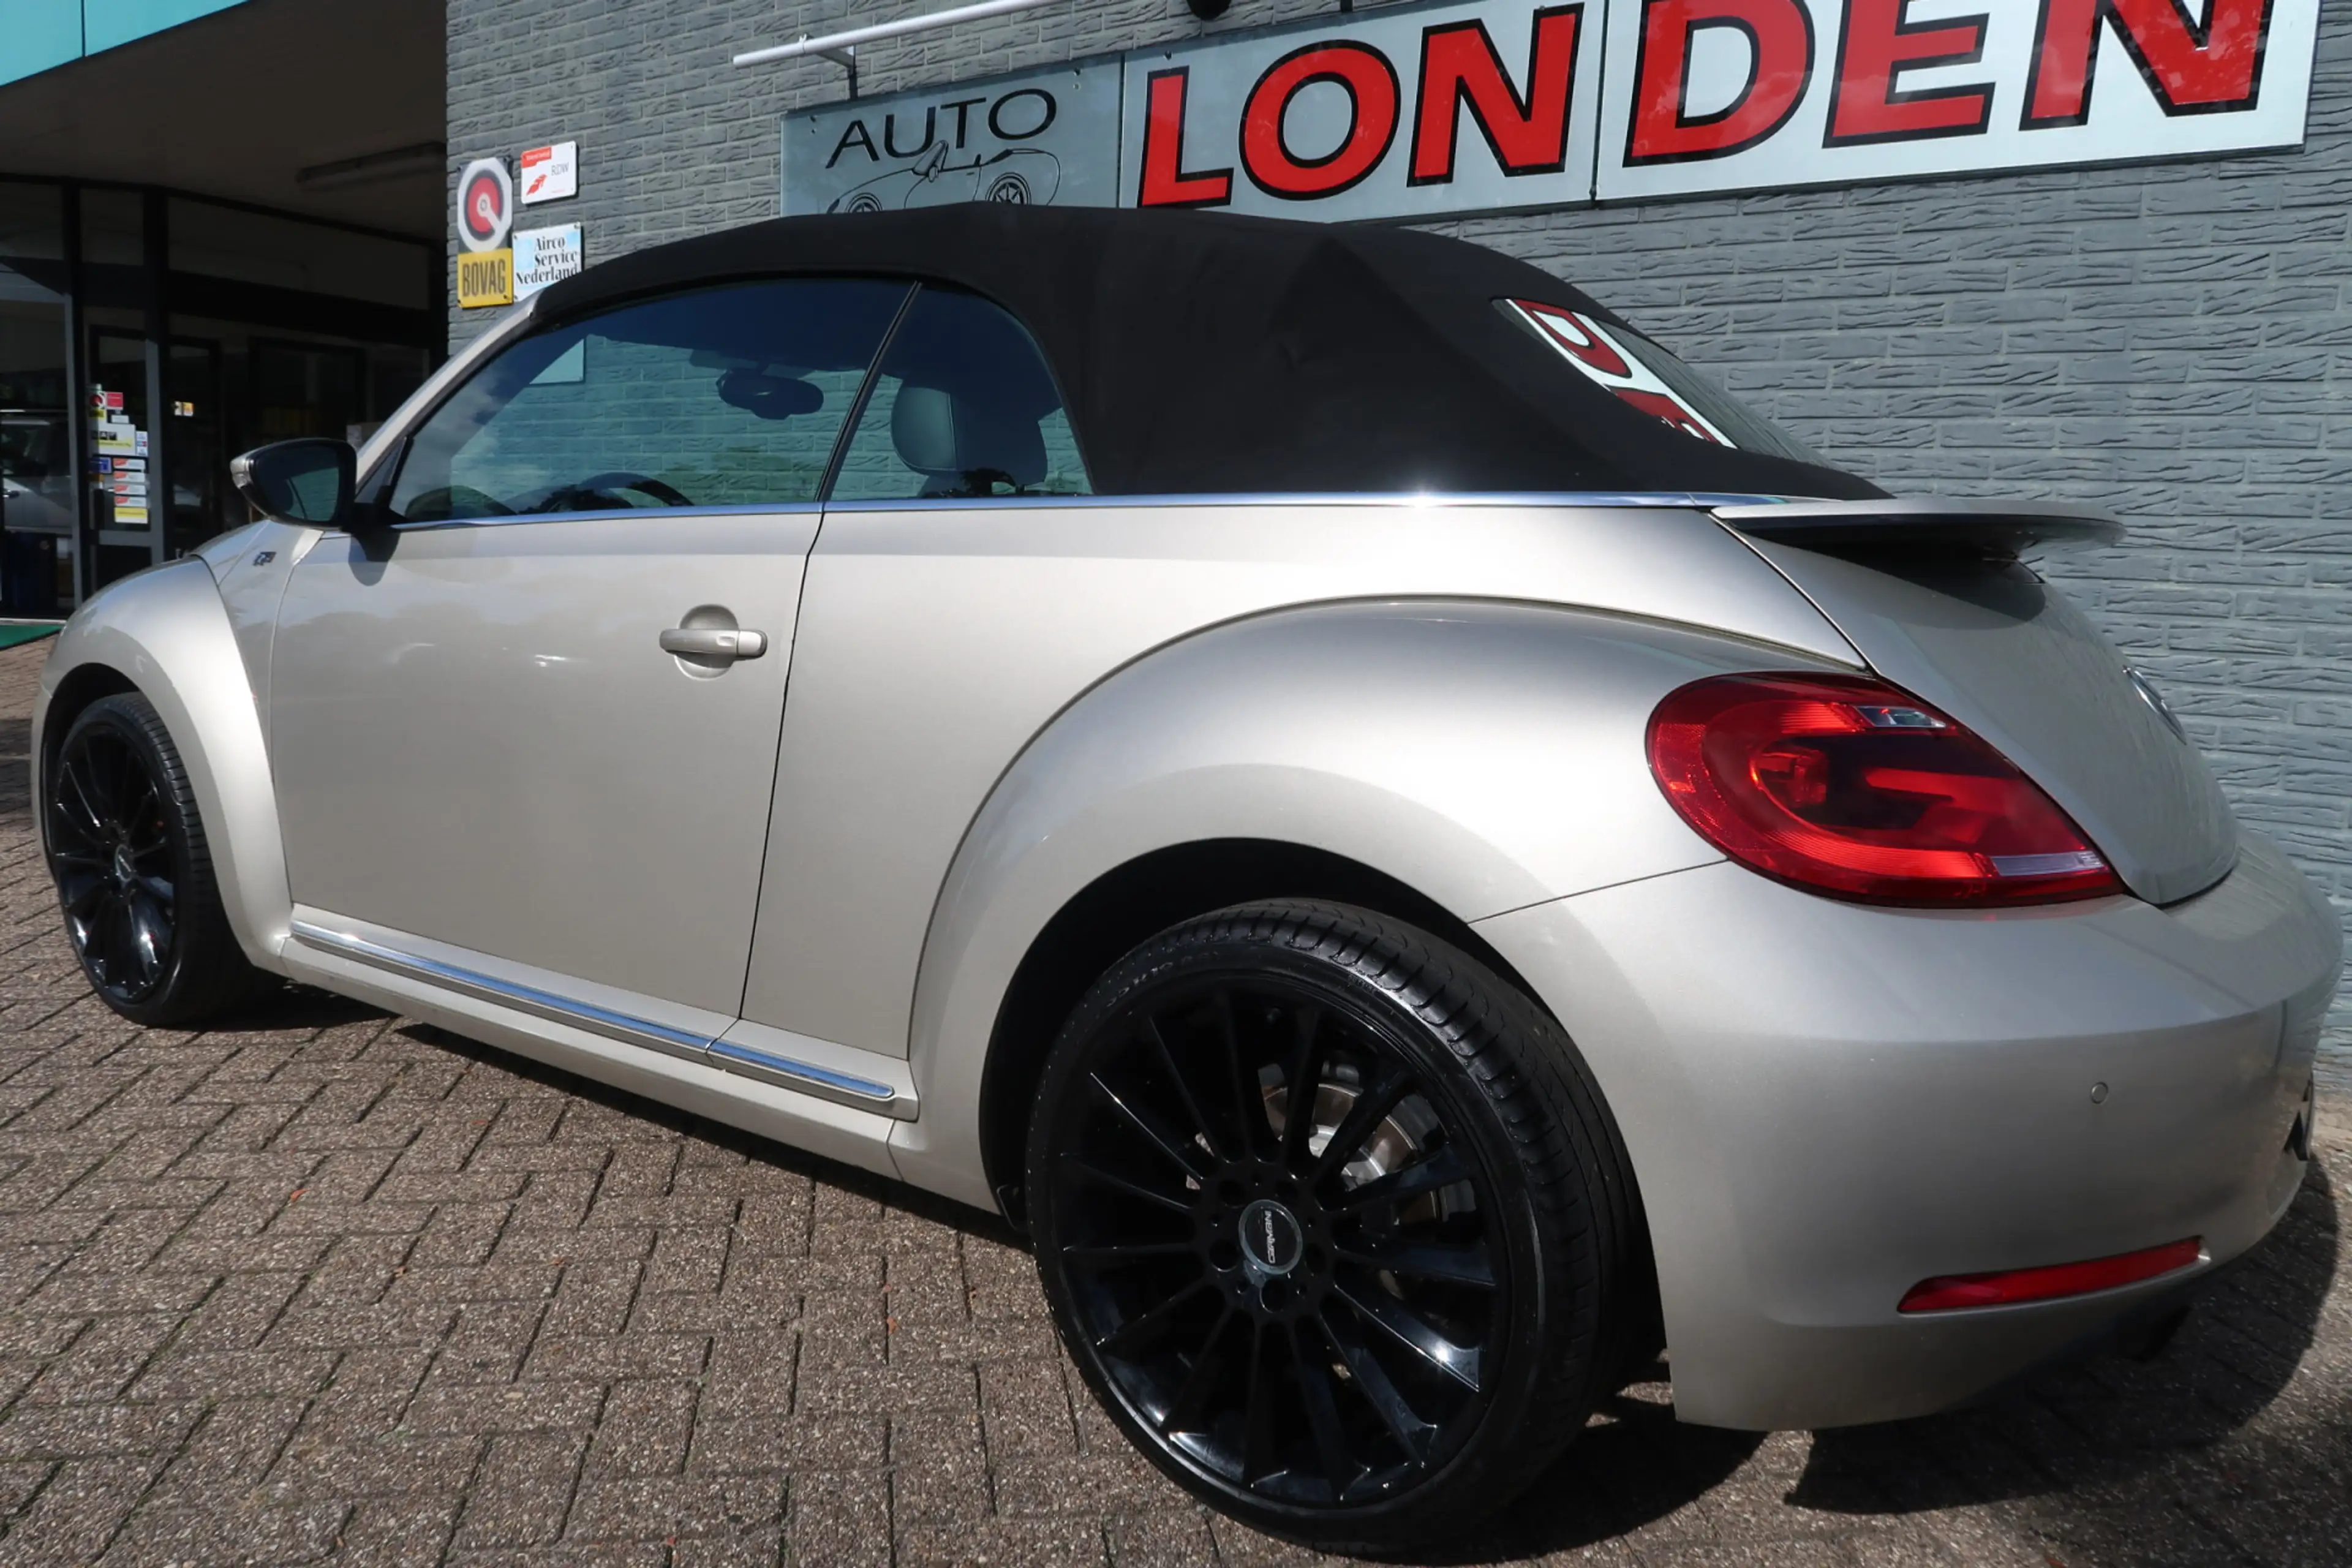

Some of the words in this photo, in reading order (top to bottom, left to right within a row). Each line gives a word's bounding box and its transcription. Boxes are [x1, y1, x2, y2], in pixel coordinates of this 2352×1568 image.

[1137, 0, 2275, 209] LONDEN
[825, 88, 1057, 169] AUTO
[551, 162, 570, 176] RDW
[535, 236, 565, 251] Airco
[535, 249, 577, 267] Service
[463, 258, 506, 297] BOVAG
[516, 263, 578, 284] Nederland
